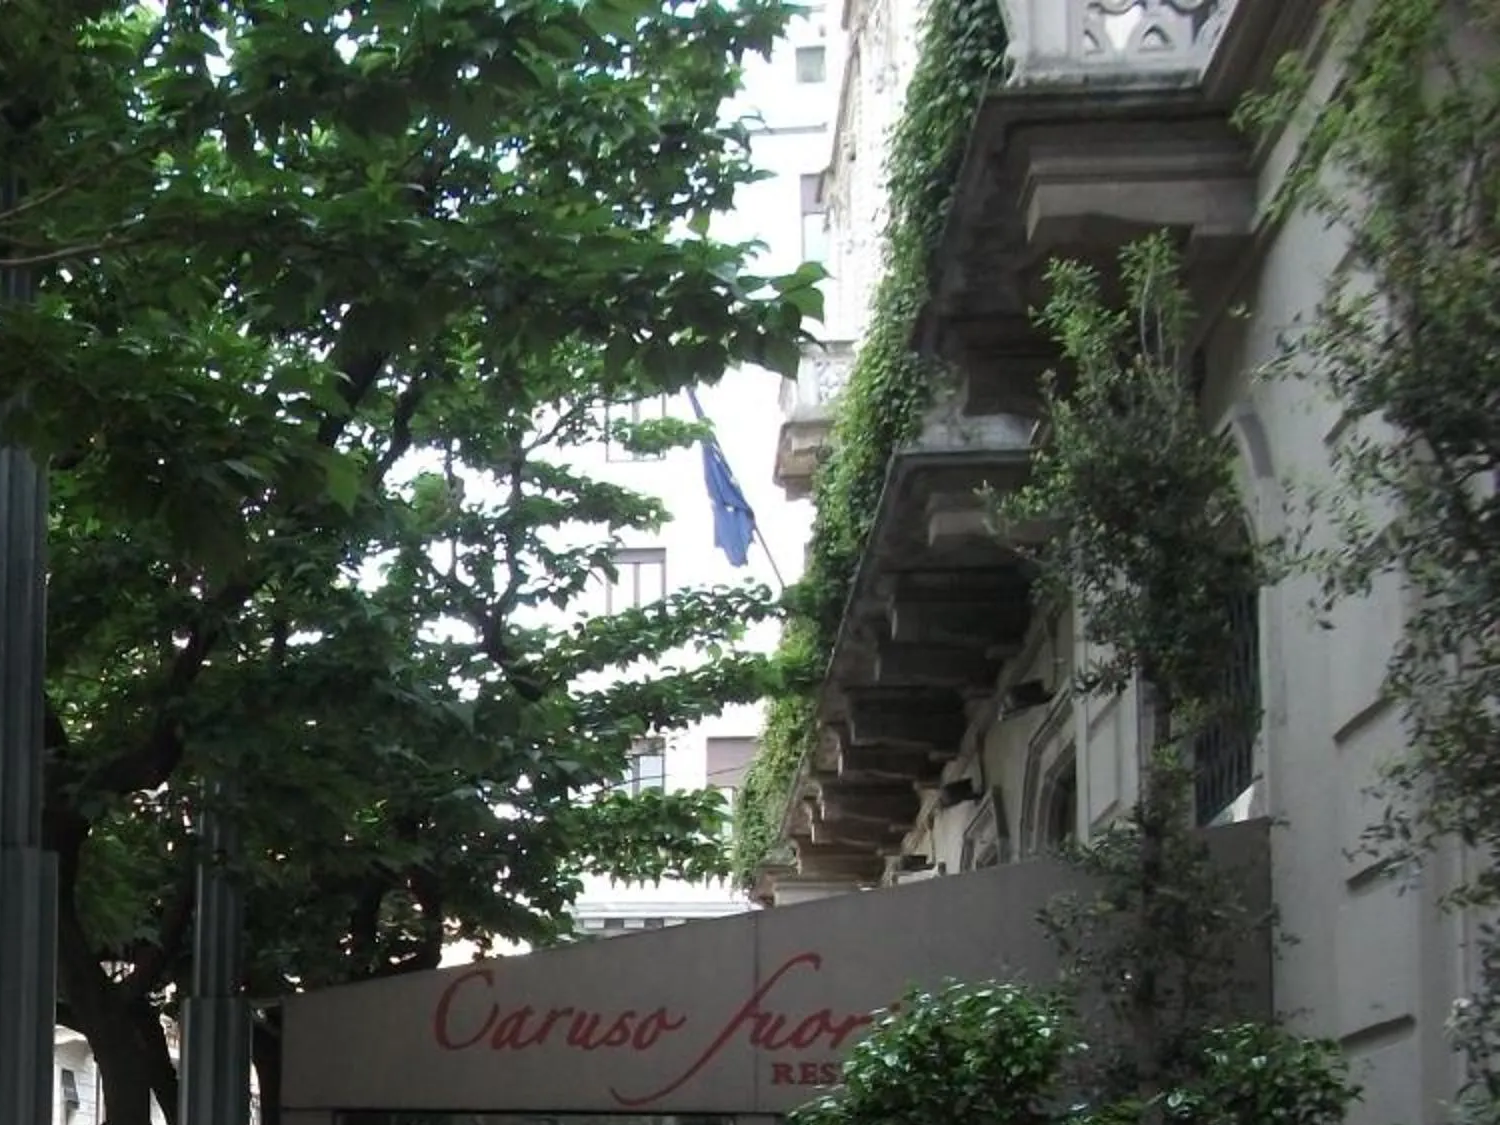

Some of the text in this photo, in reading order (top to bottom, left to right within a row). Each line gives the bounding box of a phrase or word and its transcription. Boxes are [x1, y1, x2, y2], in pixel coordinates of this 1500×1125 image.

[436, 953, 902, 1106] Caruso fuor
[771, 1062, 845, 1085] RES
